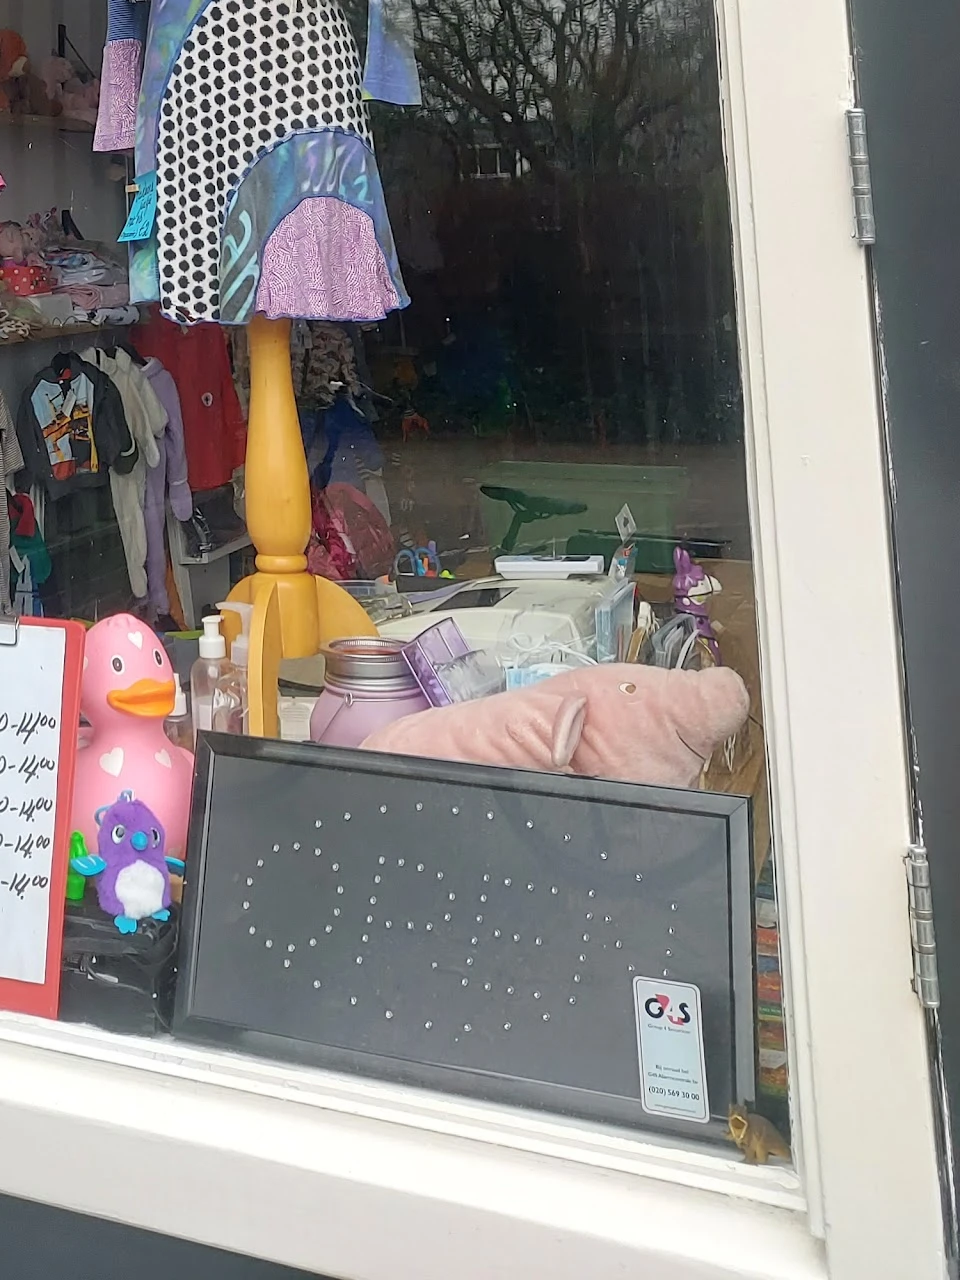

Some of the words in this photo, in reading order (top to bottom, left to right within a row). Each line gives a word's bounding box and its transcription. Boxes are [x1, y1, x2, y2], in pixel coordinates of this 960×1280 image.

[645, 994, 691, 1026] G4S
[648, 1086, 666, 1096] (020)
[667, 1089, 680, 1098] 569
[682, 1091, 690, 1099] 30
[691, 1093, 700, 1101] 00
